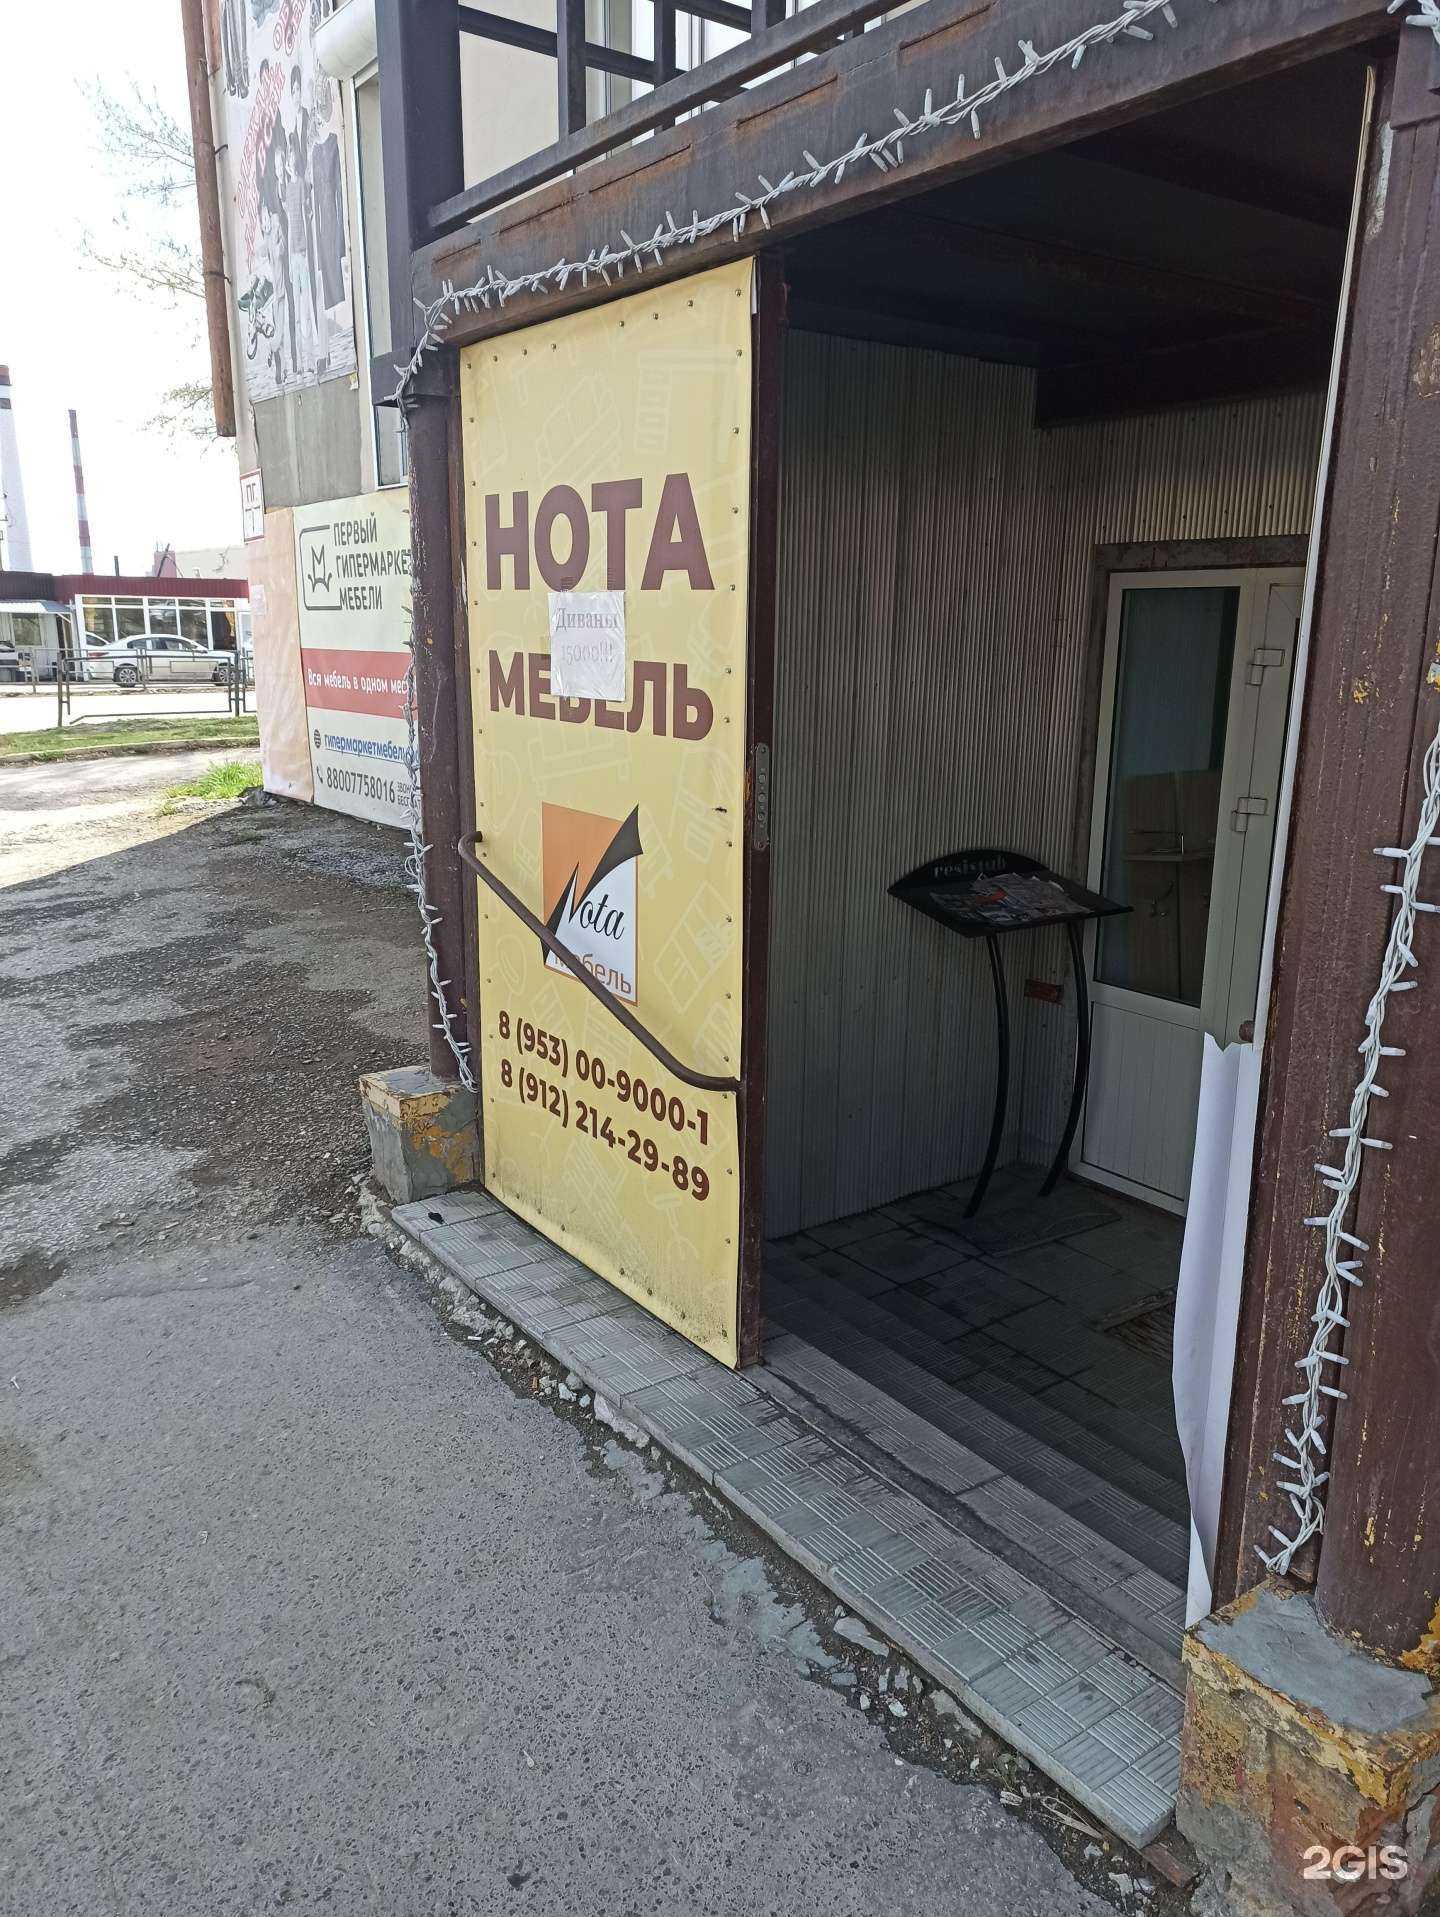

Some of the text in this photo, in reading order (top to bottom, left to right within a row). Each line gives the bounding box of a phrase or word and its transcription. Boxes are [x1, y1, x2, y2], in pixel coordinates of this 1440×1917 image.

[333, 512, 377, 546] ПЕРВЫЙ
[484, 472, 715, 591] НОТА
[336, 548, 411, 579] ГИПЕРМАРКЕ
[340, 585, 382, 610] МЕБЕЛИ
[555, 607, 618, 632] Диваны
[308, 668, 321, 687] Вся
[324, 670, 351, 689] мебель
[353, 677, 359, 690] в
[361, 676, 388, 694] одном
[326, 766, 395, 803] 88007758016
[554, 953, 632, 994] бель
[498, 1010, 708, 1146] 8 (953) 00-9000-1
[501, 1058, 709, 1201] 8 (912) 214-29-89
